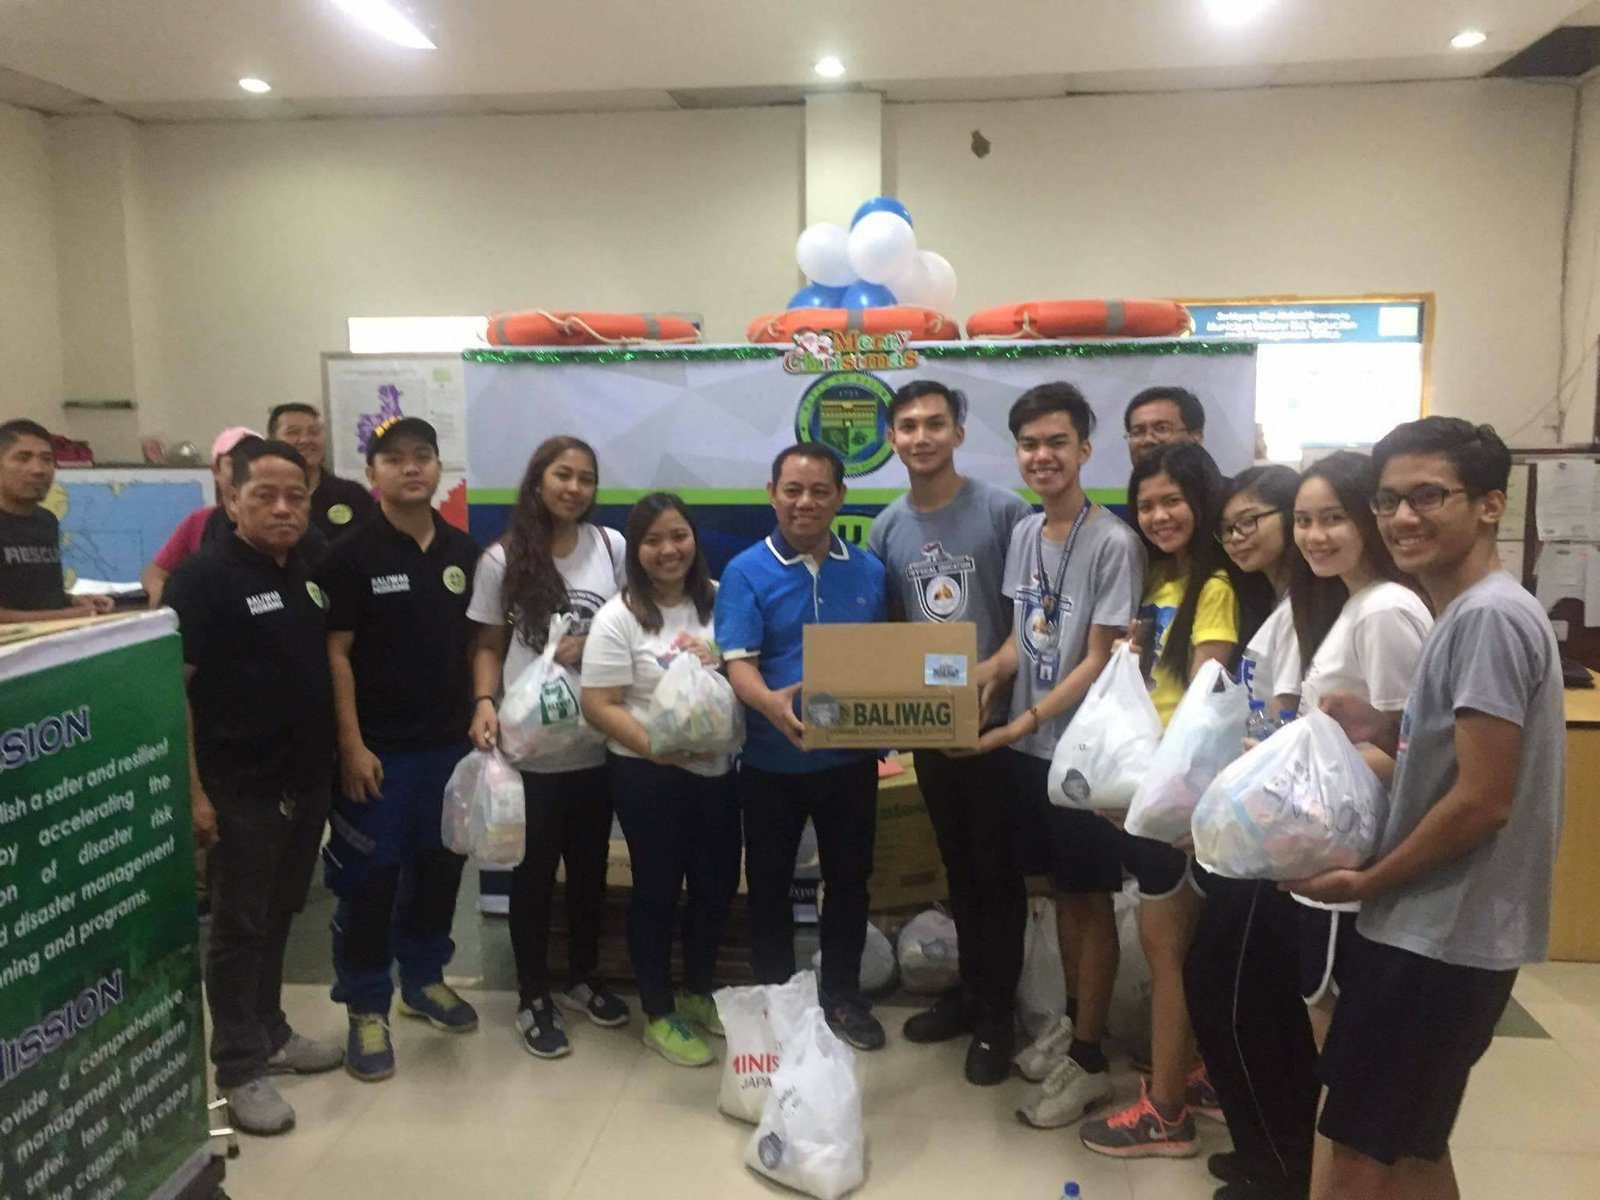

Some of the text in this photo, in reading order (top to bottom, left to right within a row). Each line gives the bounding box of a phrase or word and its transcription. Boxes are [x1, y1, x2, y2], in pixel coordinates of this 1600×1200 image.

[783, 350, 918, 374] Christmas
[833, 329, 912, 353] Merry
[853, 702, 951, 727] BALIWAG
[30, 793, 44, 811] a
[45, 776, 83, 805] safer
[86, 758, 116, 787] and
[118, 737, 169, 774] resilient
[39, 790, 134, 846] accelerating
[149, 774, 171, 795] the
[41, 858, 57, 884] of
[78, 826, 133, 865] disaster
[151, 804, 173, 829] risk
[14, 891, 76, 937] disaster
[81, 834, 175, 901] management
[44, 925, 76, 960] and
[58, 1073, 70, 1091] a
[80, 989, 184, 1075] comprehensive
[17, 1020, 186, 1164] management program
[81, 1117, 109, 1149] less
[120, 1052, 187, 1114] vulnerable
[140, 1113, 155, 1133] to
